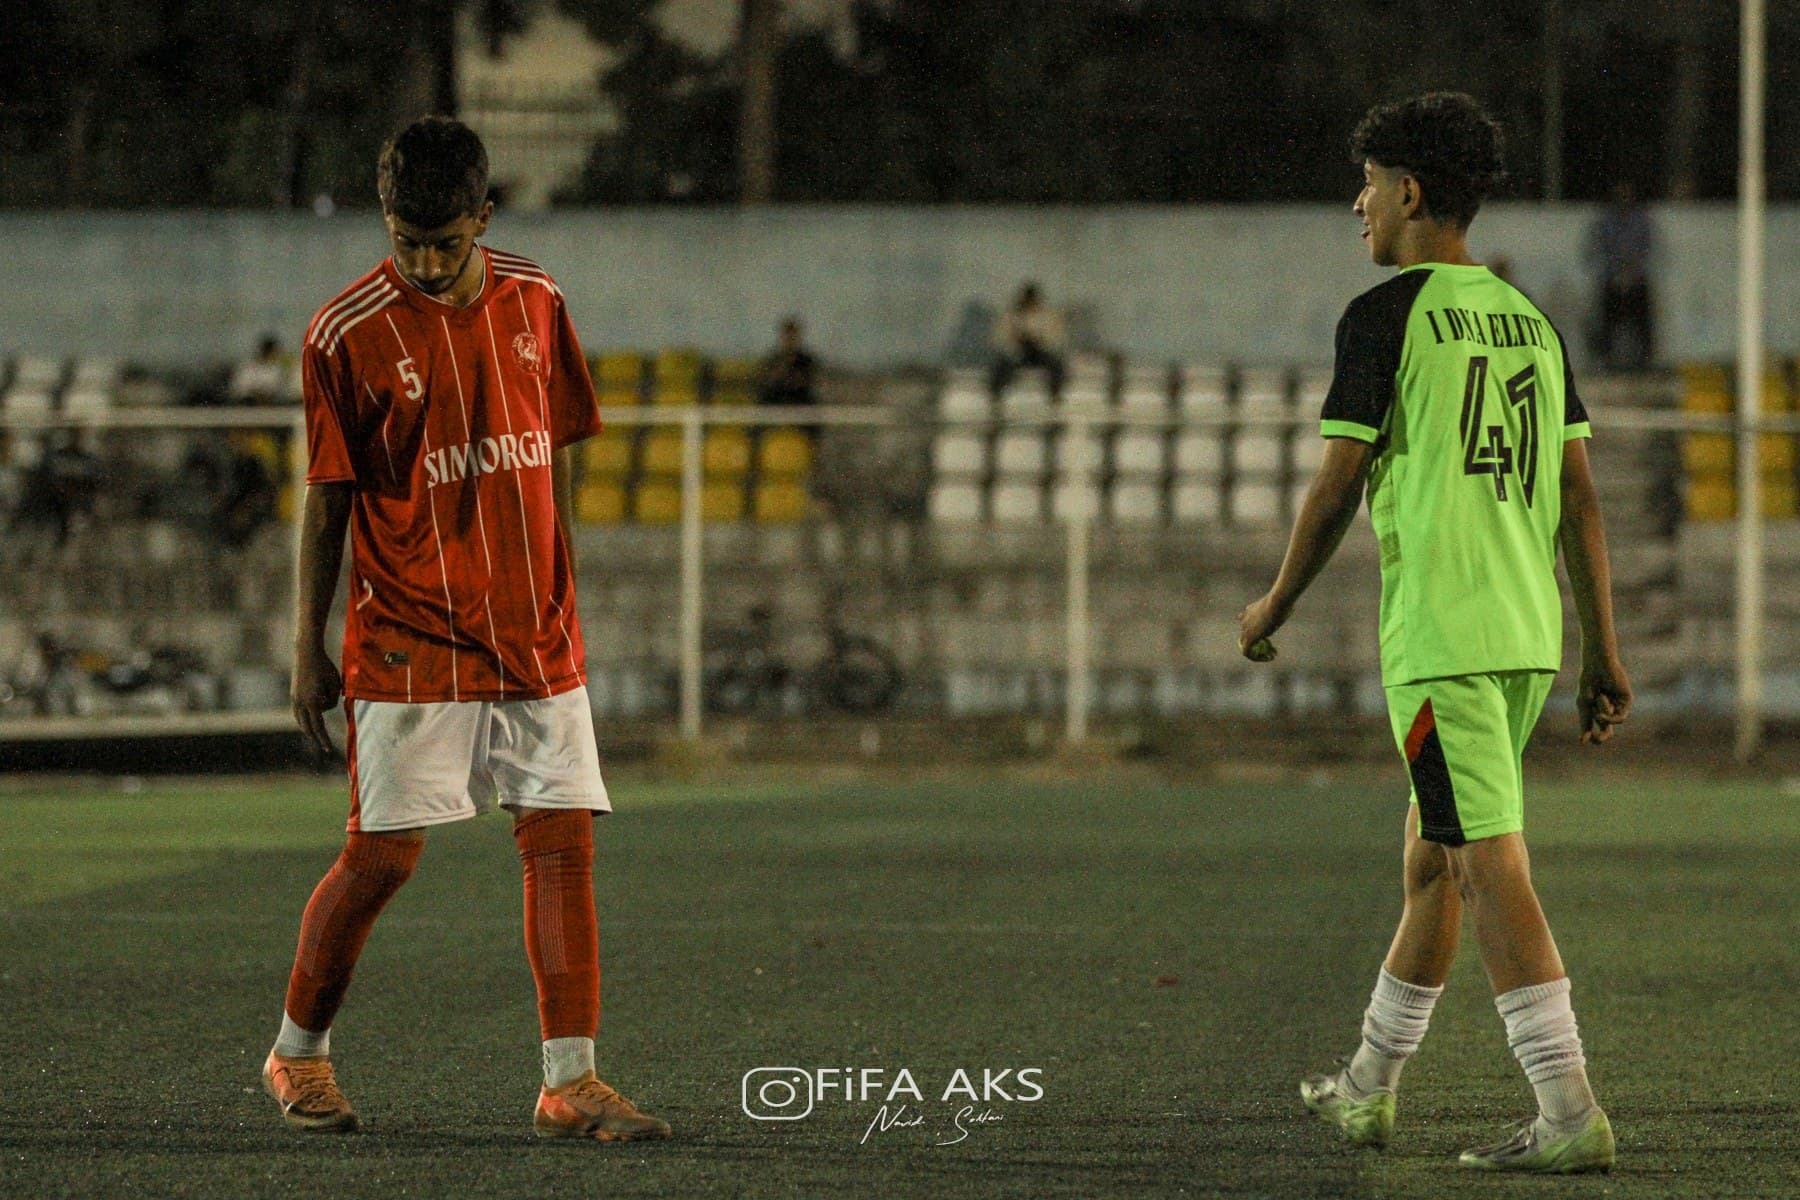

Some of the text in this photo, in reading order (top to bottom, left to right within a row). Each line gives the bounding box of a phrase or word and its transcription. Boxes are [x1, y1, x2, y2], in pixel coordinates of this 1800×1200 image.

[1425, 308, 1548, 352] I DNA ELITE
[396, 356, 424, 401] 5
[1459, 355, 1538, 509] 41
[423, 430, 552, 488] SIMORGH
